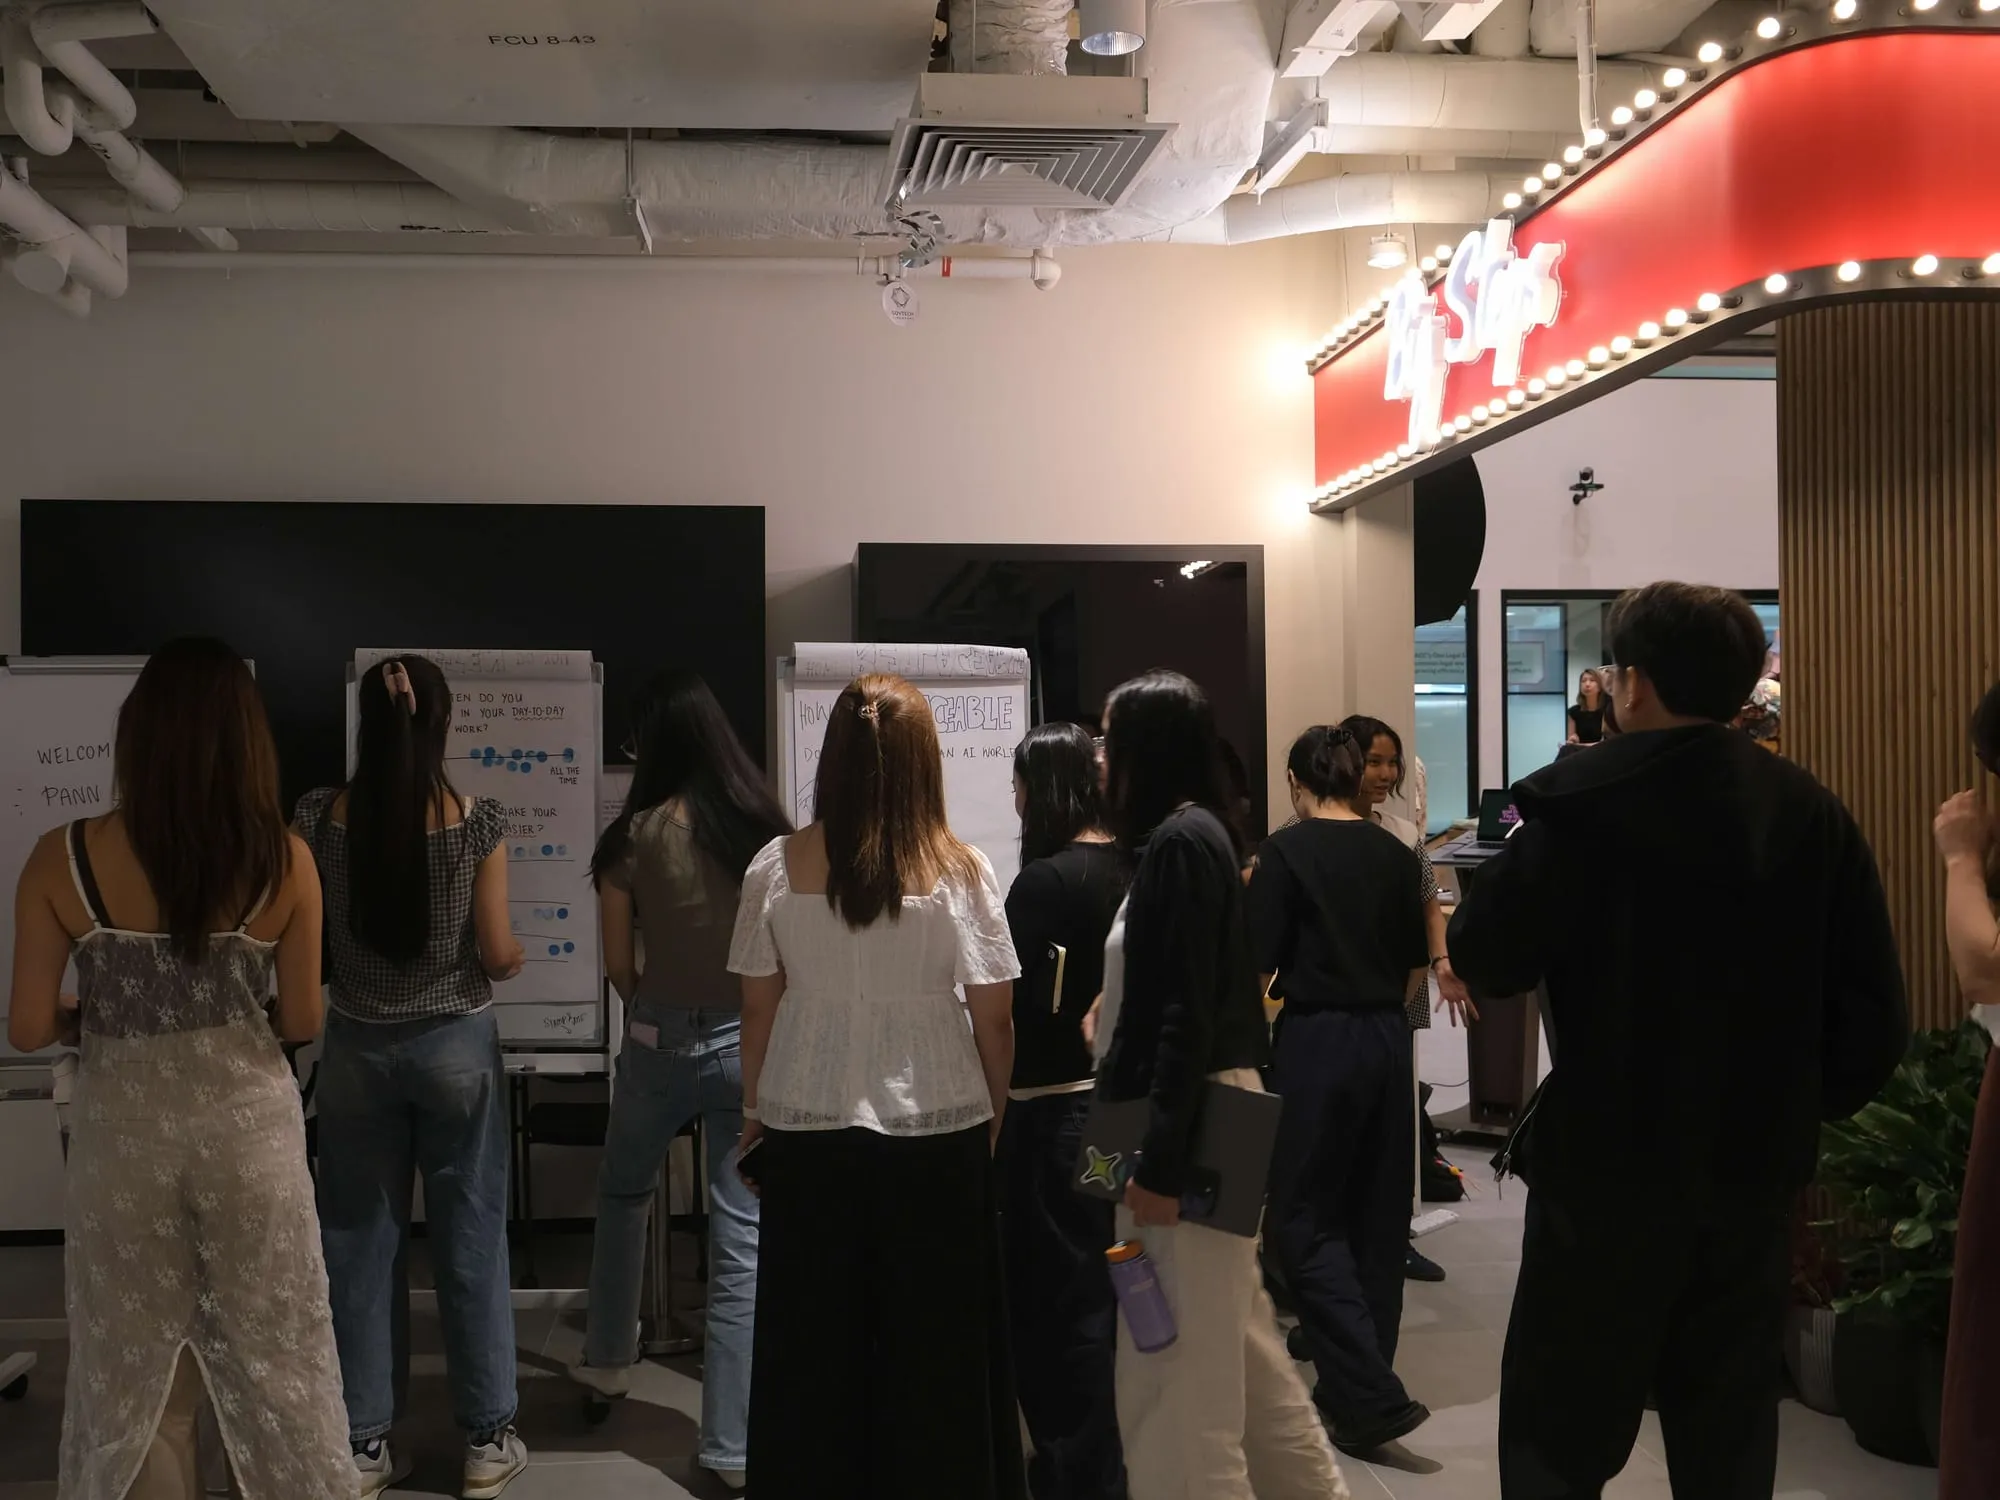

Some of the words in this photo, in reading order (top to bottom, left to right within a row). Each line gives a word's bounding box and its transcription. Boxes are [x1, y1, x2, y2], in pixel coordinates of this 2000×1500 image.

[488, 35, 539, 45] FCU
[546, 35, 596, 45] 8-43
[448, 692, 471, 703] TEN
[479, 692, 494, 703] DO
[501, 692, 523, 704] YOU
[460, 707, 471, 718] IN
[480, 706, 505, 719] YOUR
[512, 705, 565, 718] DAY-TO-DAY
[923, 694, 1013, 733] CEABLE
[454, 723, 489, 734] WORK?
[37, 742, 110, 765] WELCOM
[963, 746, 977, 758] AI
[550, 767, 563, 776] ALL
[566, 766, 581, 775] THE
[559, 776, 578, 785] TIME
[532, 807, 558, 817] YOUR
